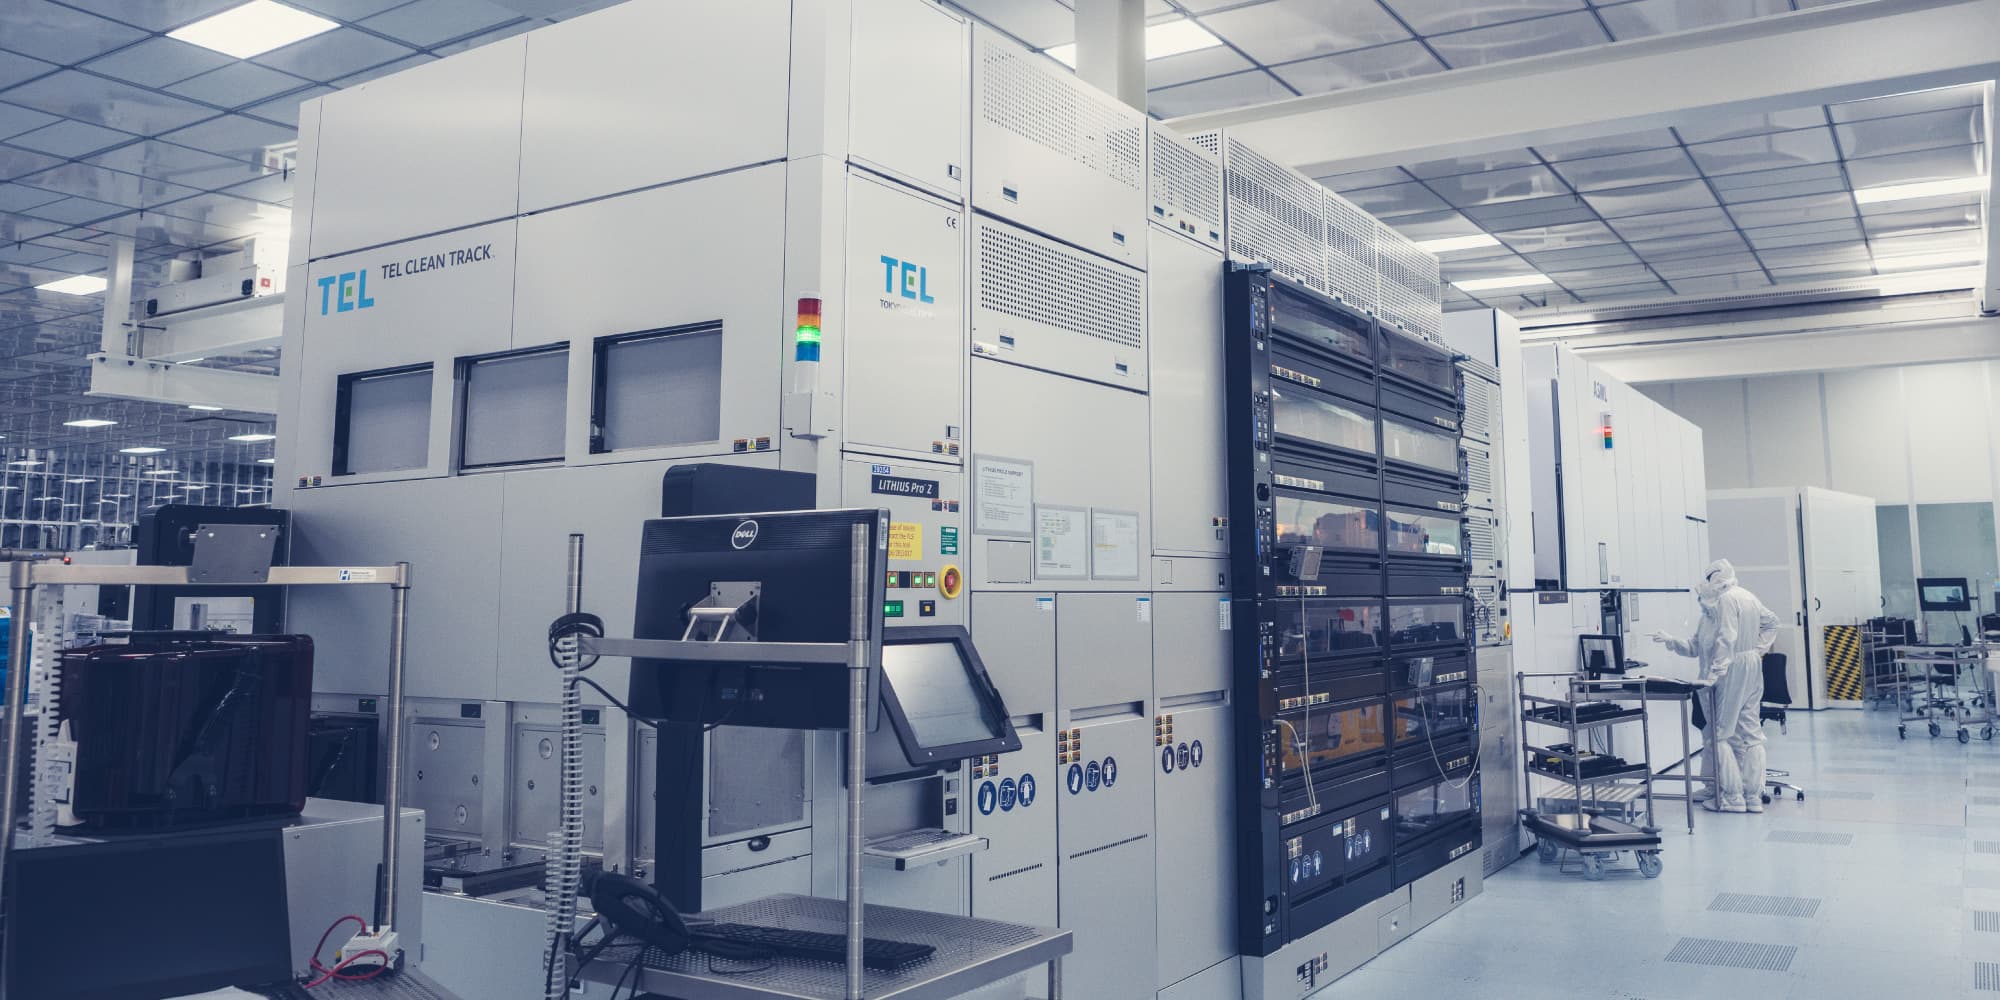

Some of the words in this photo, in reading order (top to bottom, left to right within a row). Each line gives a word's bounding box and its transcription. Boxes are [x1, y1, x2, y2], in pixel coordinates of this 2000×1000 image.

[381, 265, 402, 280] TEL
[405, 254, 445, 275] CLEAN
[449, 243, 492, 267] TRACK
[880, 254, 935, 305] TEL
[317, 269, 375, 316] TEL
[878, 479, 910, 493] LITHIUS
[927, 484, 933, 495] Z
[735, 530, 754, 538] DELL
